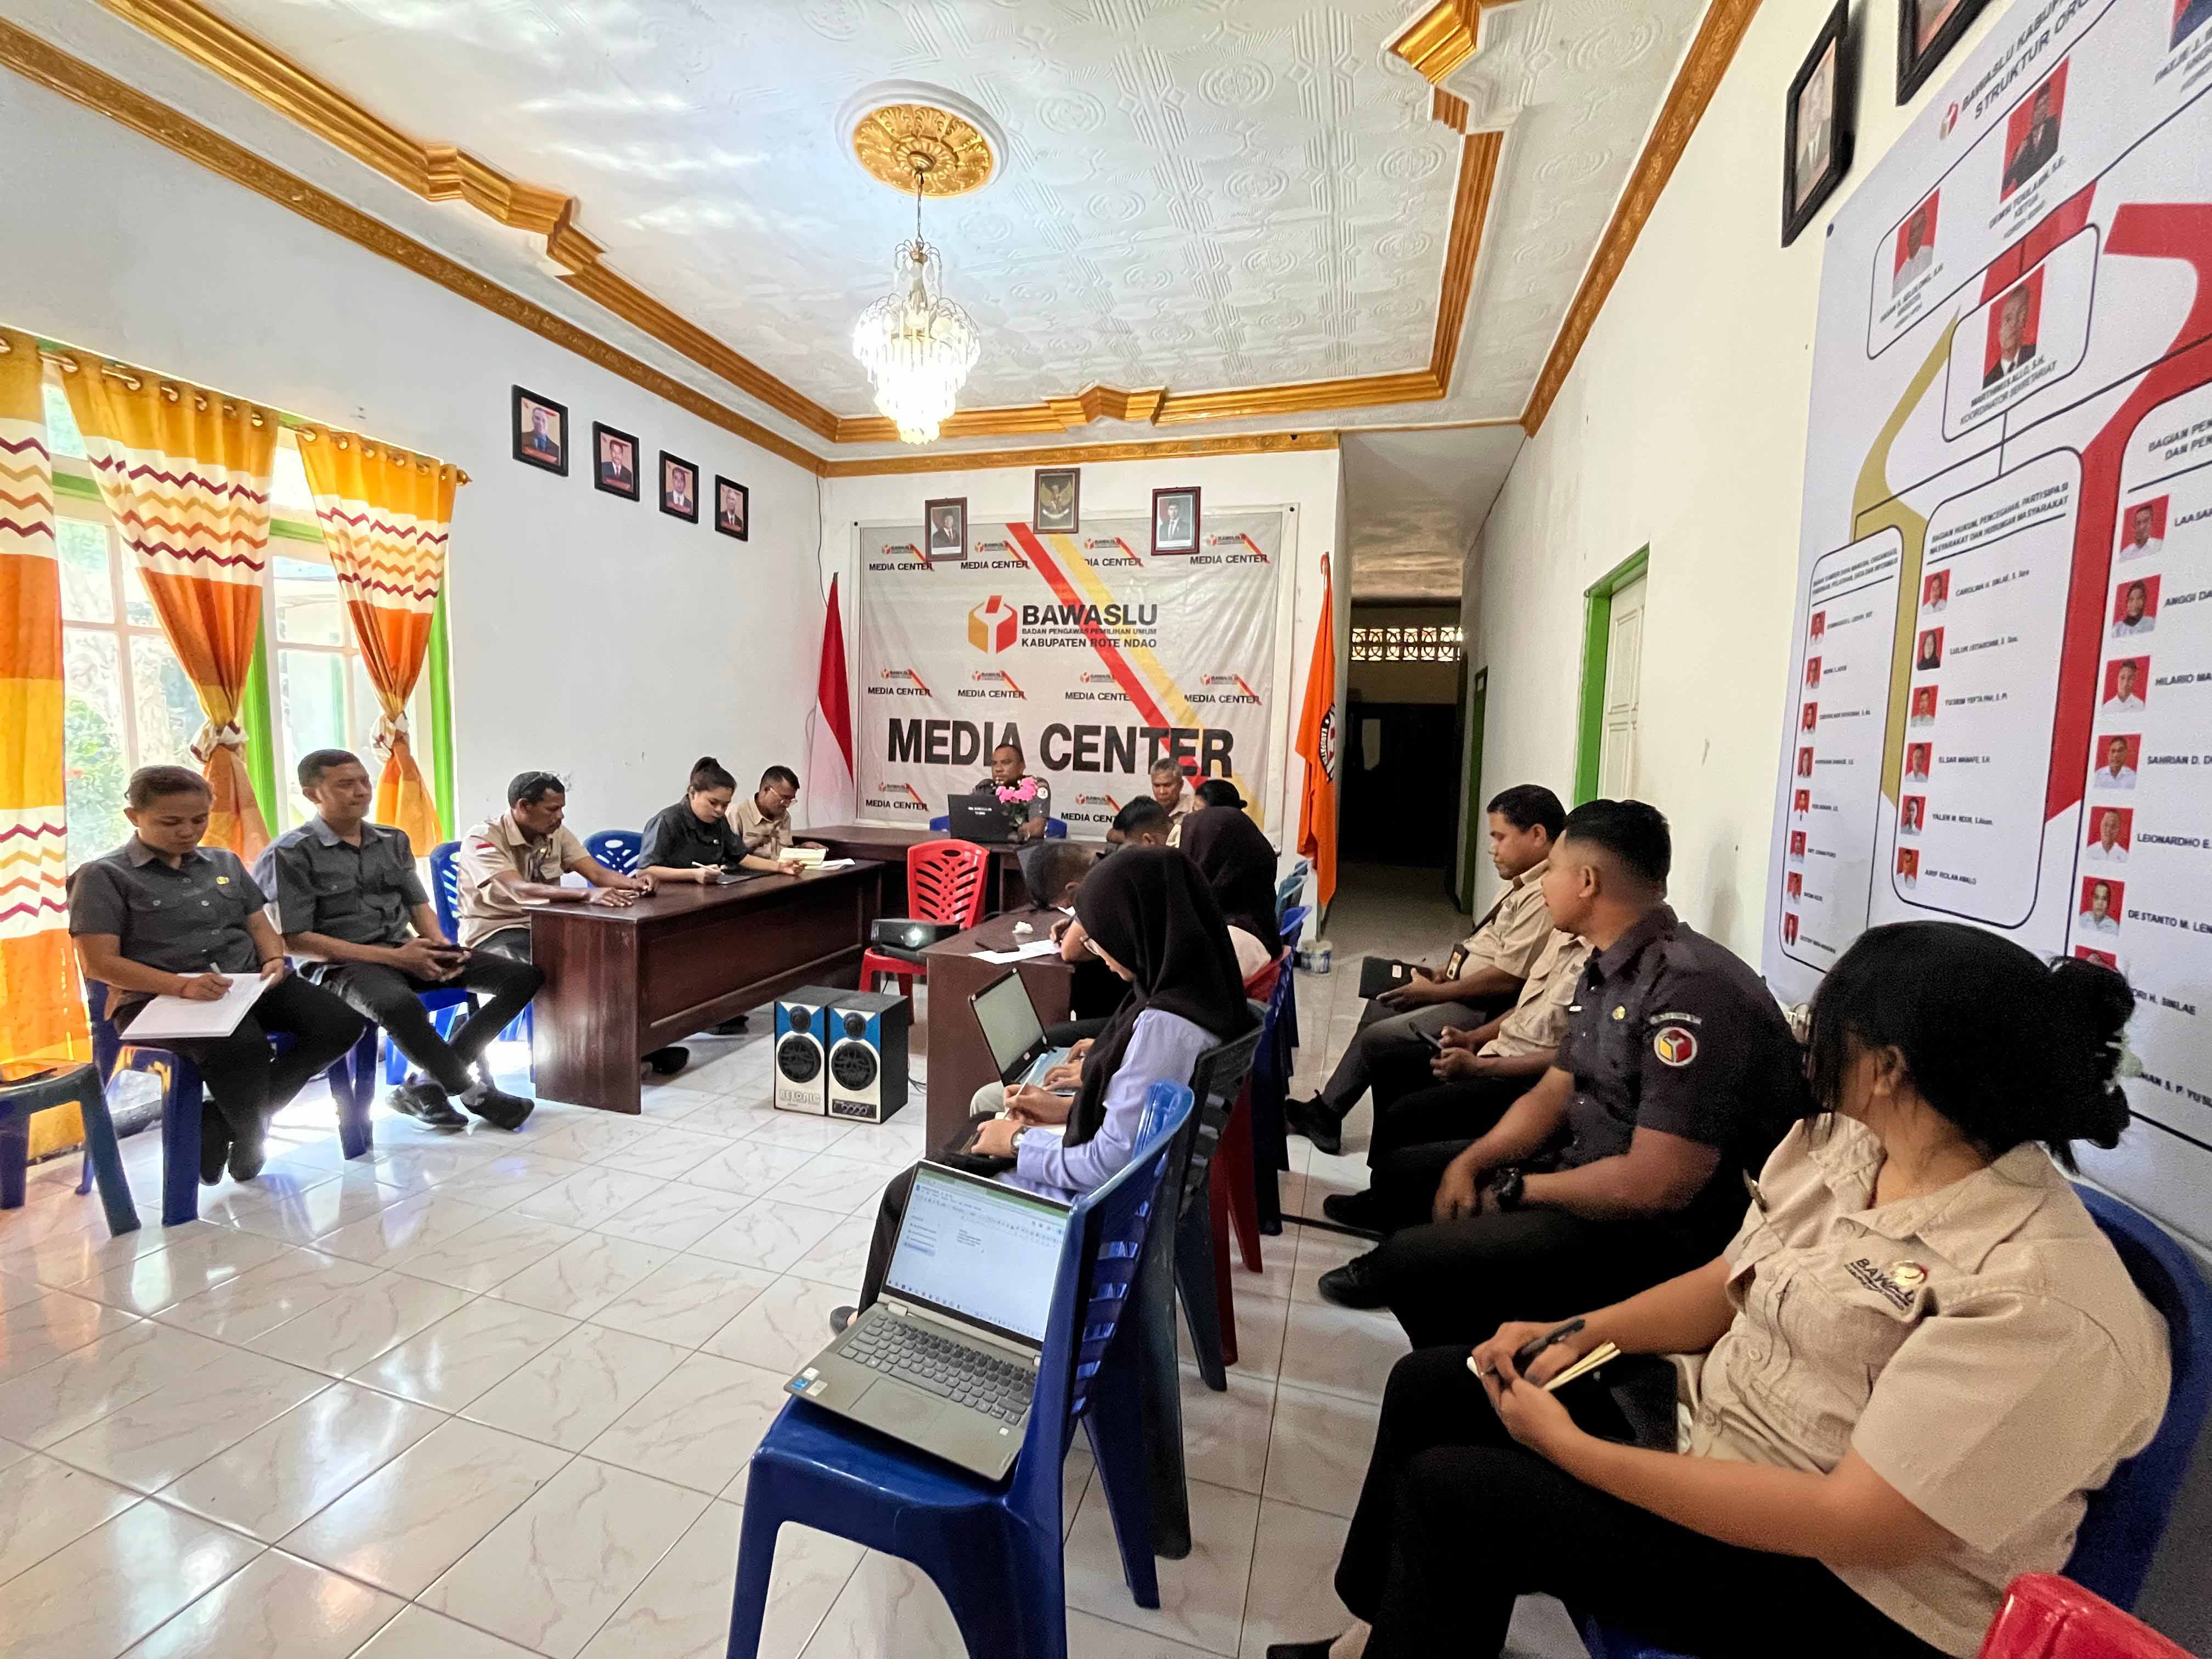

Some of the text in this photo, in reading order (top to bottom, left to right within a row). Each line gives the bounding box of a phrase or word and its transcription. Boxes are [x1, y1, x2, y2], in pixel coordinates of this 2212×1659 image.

[1975, 30, 2050, 120] STRUKTUR
[2148, 428, 2188, 452] BAGIAN
[961, 561, 1028, 569] MEDIA CENTER
[1102, 558, 1141, 566] CENTER
[1190, 555, 1267, 565] MEDIA CENTER
[869, 562, 933, 571] MEDIA CENTER
[1022, 603, 1158, 626] BAWASLU
[1022, 638, 1157, 648] KABUPATEN ROTE NDAO
[868, 687, 930, 696] MEDIA CENTER
[958, 690, 1025, 698] MEDIA CENTER
[1065, 692, 1131, 701] MEDIA CENTE
[1184, 694, 1260, 704] MEDIA CENTER
[888, 718, 1234, 777] MEDIA CENTER
[866, 799, 928, 810] MEDIA CENTER
[1061, 812, 1090, 821] MEDIA
